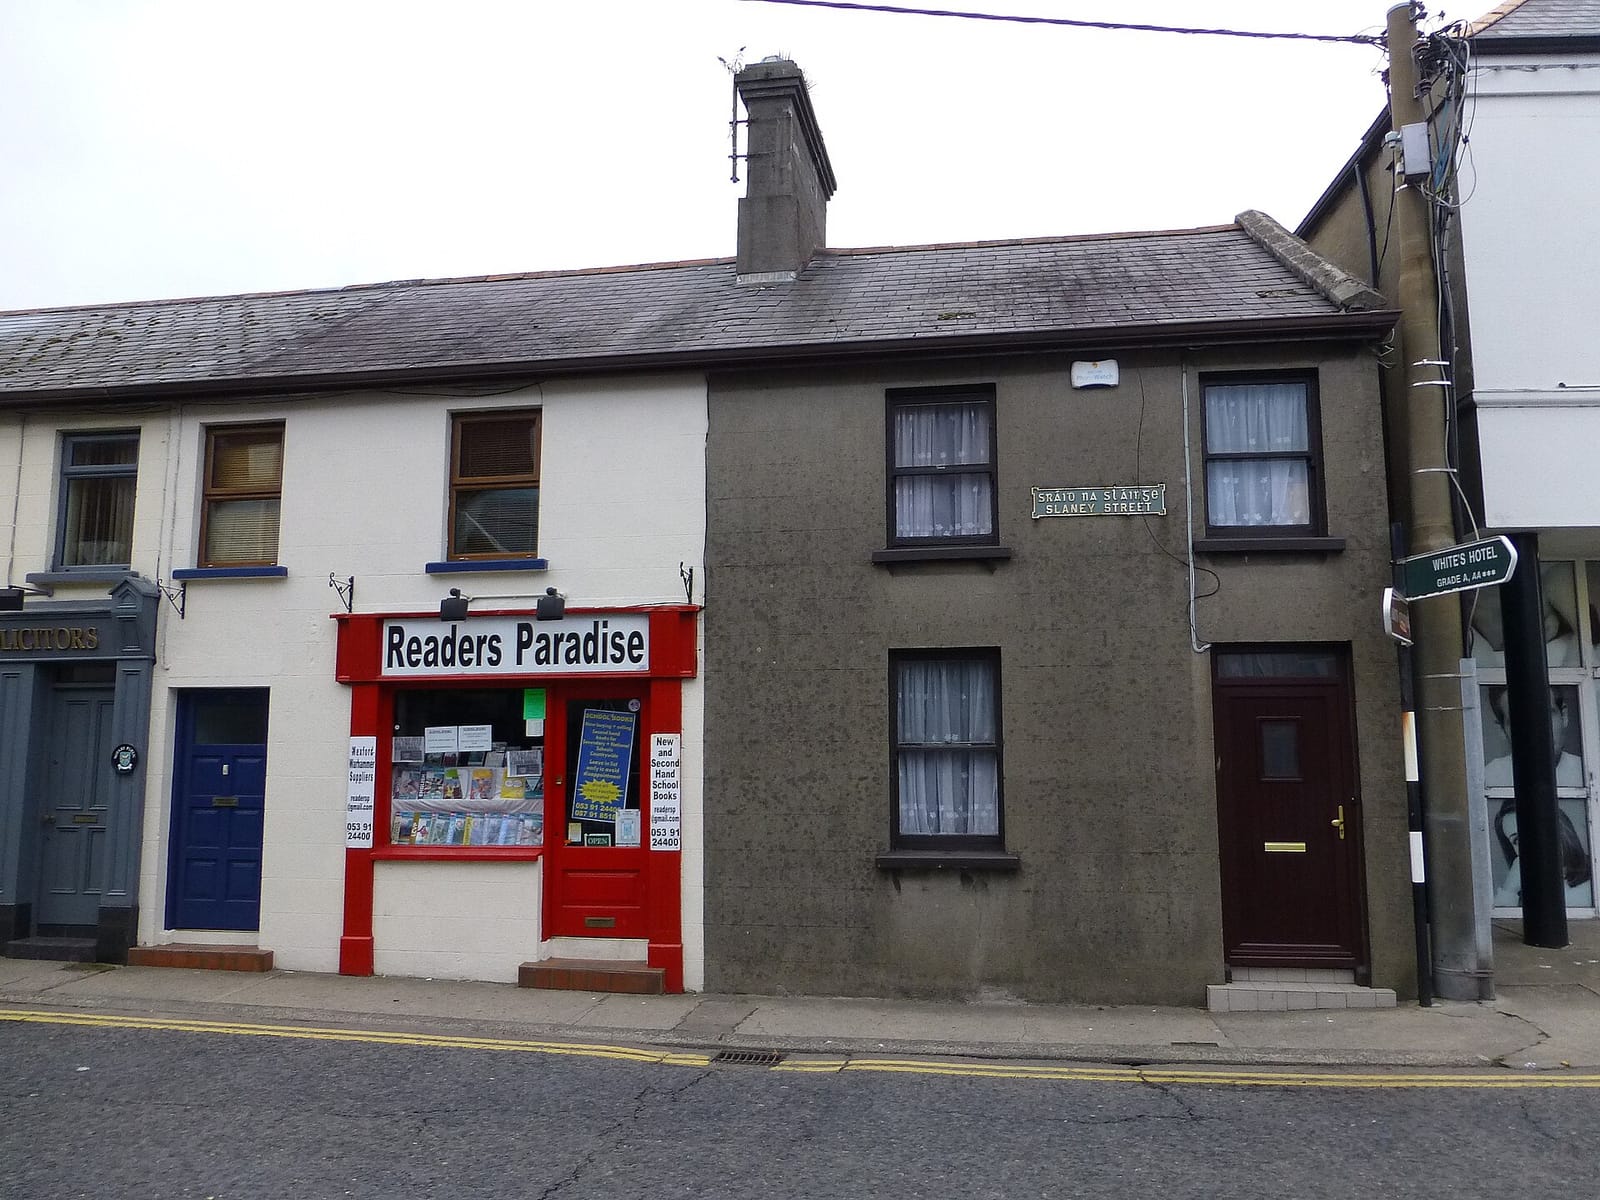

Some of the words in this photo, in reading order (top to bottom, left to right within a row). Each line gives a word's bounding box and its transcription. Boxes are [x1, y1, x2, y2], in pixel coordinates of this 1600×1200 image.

[1046, 503, 1095, 514] SLANEY
[1104, 502, 1152, 513] STREET
[1432, 553, 1466, 572] WHITE'S
[1468, 546, 1498, 563] HOTEL
[1436, 574, 1461, 588] GRADE
[387, 624, 502, 668] Readers
[516, 620, 645, 665] Paradise
[656, 737, 674, 746] New
[351, 746, 374, 756] Wexford
[658, 748, 673, 757] and
[651, 758, 680, 768] Second
[349, 771, 374, 784] Suppliers
[655, 769, 676, 778] Hand
[652, 780, 679, 789] School
[653, 791, 677, 800] Books
[346, 822, 361, 831] 053
[362, 822, 372, 831] 91
[347, 832, 371, 841] 24400
[651, 828, 667, 837] 053
[669, 828, 680, 837] 91
[587, 837, 608, 845] OPEN
[652, 838, 679, 847] 24400
